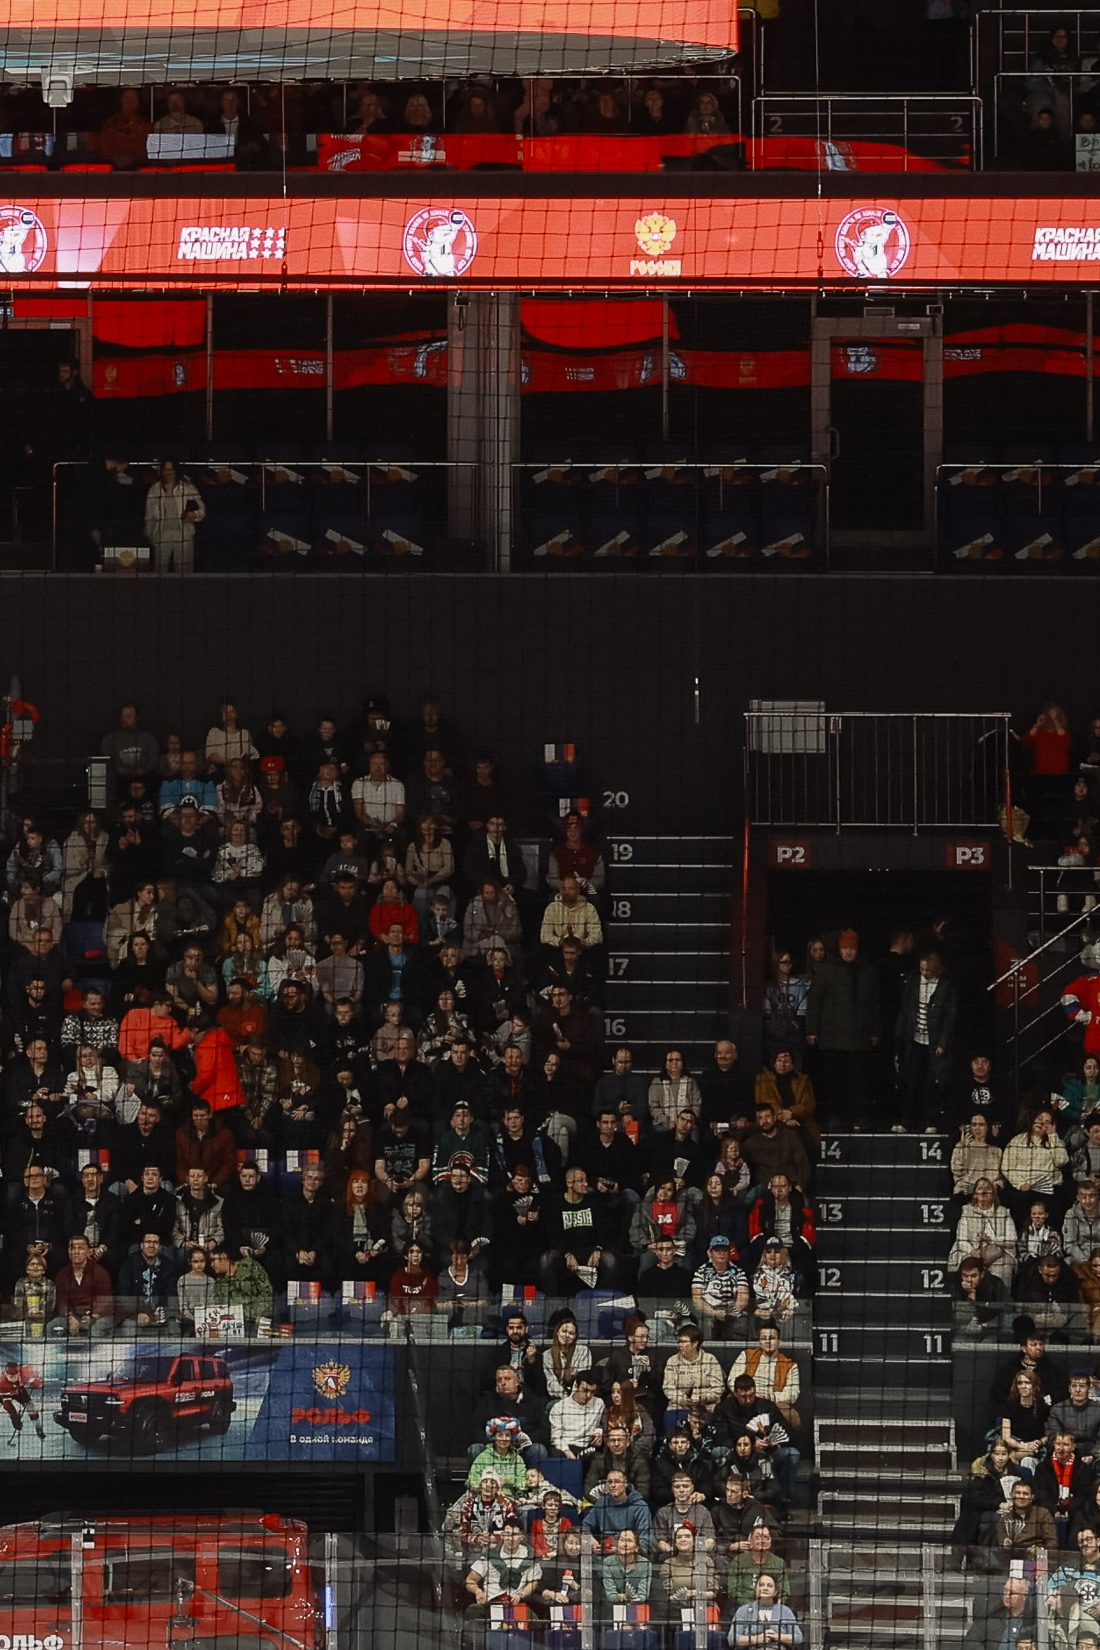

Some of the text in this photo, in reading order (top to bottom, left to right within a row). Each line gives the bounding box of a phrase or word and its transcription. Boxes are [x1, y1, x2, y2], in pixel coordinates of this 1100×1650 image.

[770, 116, 784, 132] 2
[950, 116, 964, 132] 2
[180, 227, 250, 242] КРАСНАЯ
[177, 242, 248, 260] МАШИНА
[603, 791, 629, 808] 20
[611, 843, 633, 861] 19
[777, 846, 805, 863] P2
[956, 847, 983, 865] P3
[612, 901, 632, 918] 18
[608, 959, 628, 976] 17
[604, 1019, 626, 1036] 16
[820, 1141, 842, 1159] 14
[920, 1142, 942, 1160] 14
[819, 1203, 843, 1222] 13
[921, 1205, 944, 1223] 13
[819, 1268, 841, 1287] 12
[921, 1270, 944, 1289] 12
[820, 1333, 838, 1351] 11
[923, 1335, 942, 1353] 11
[292, 1407, 372, 1425] РОЛЬФ
